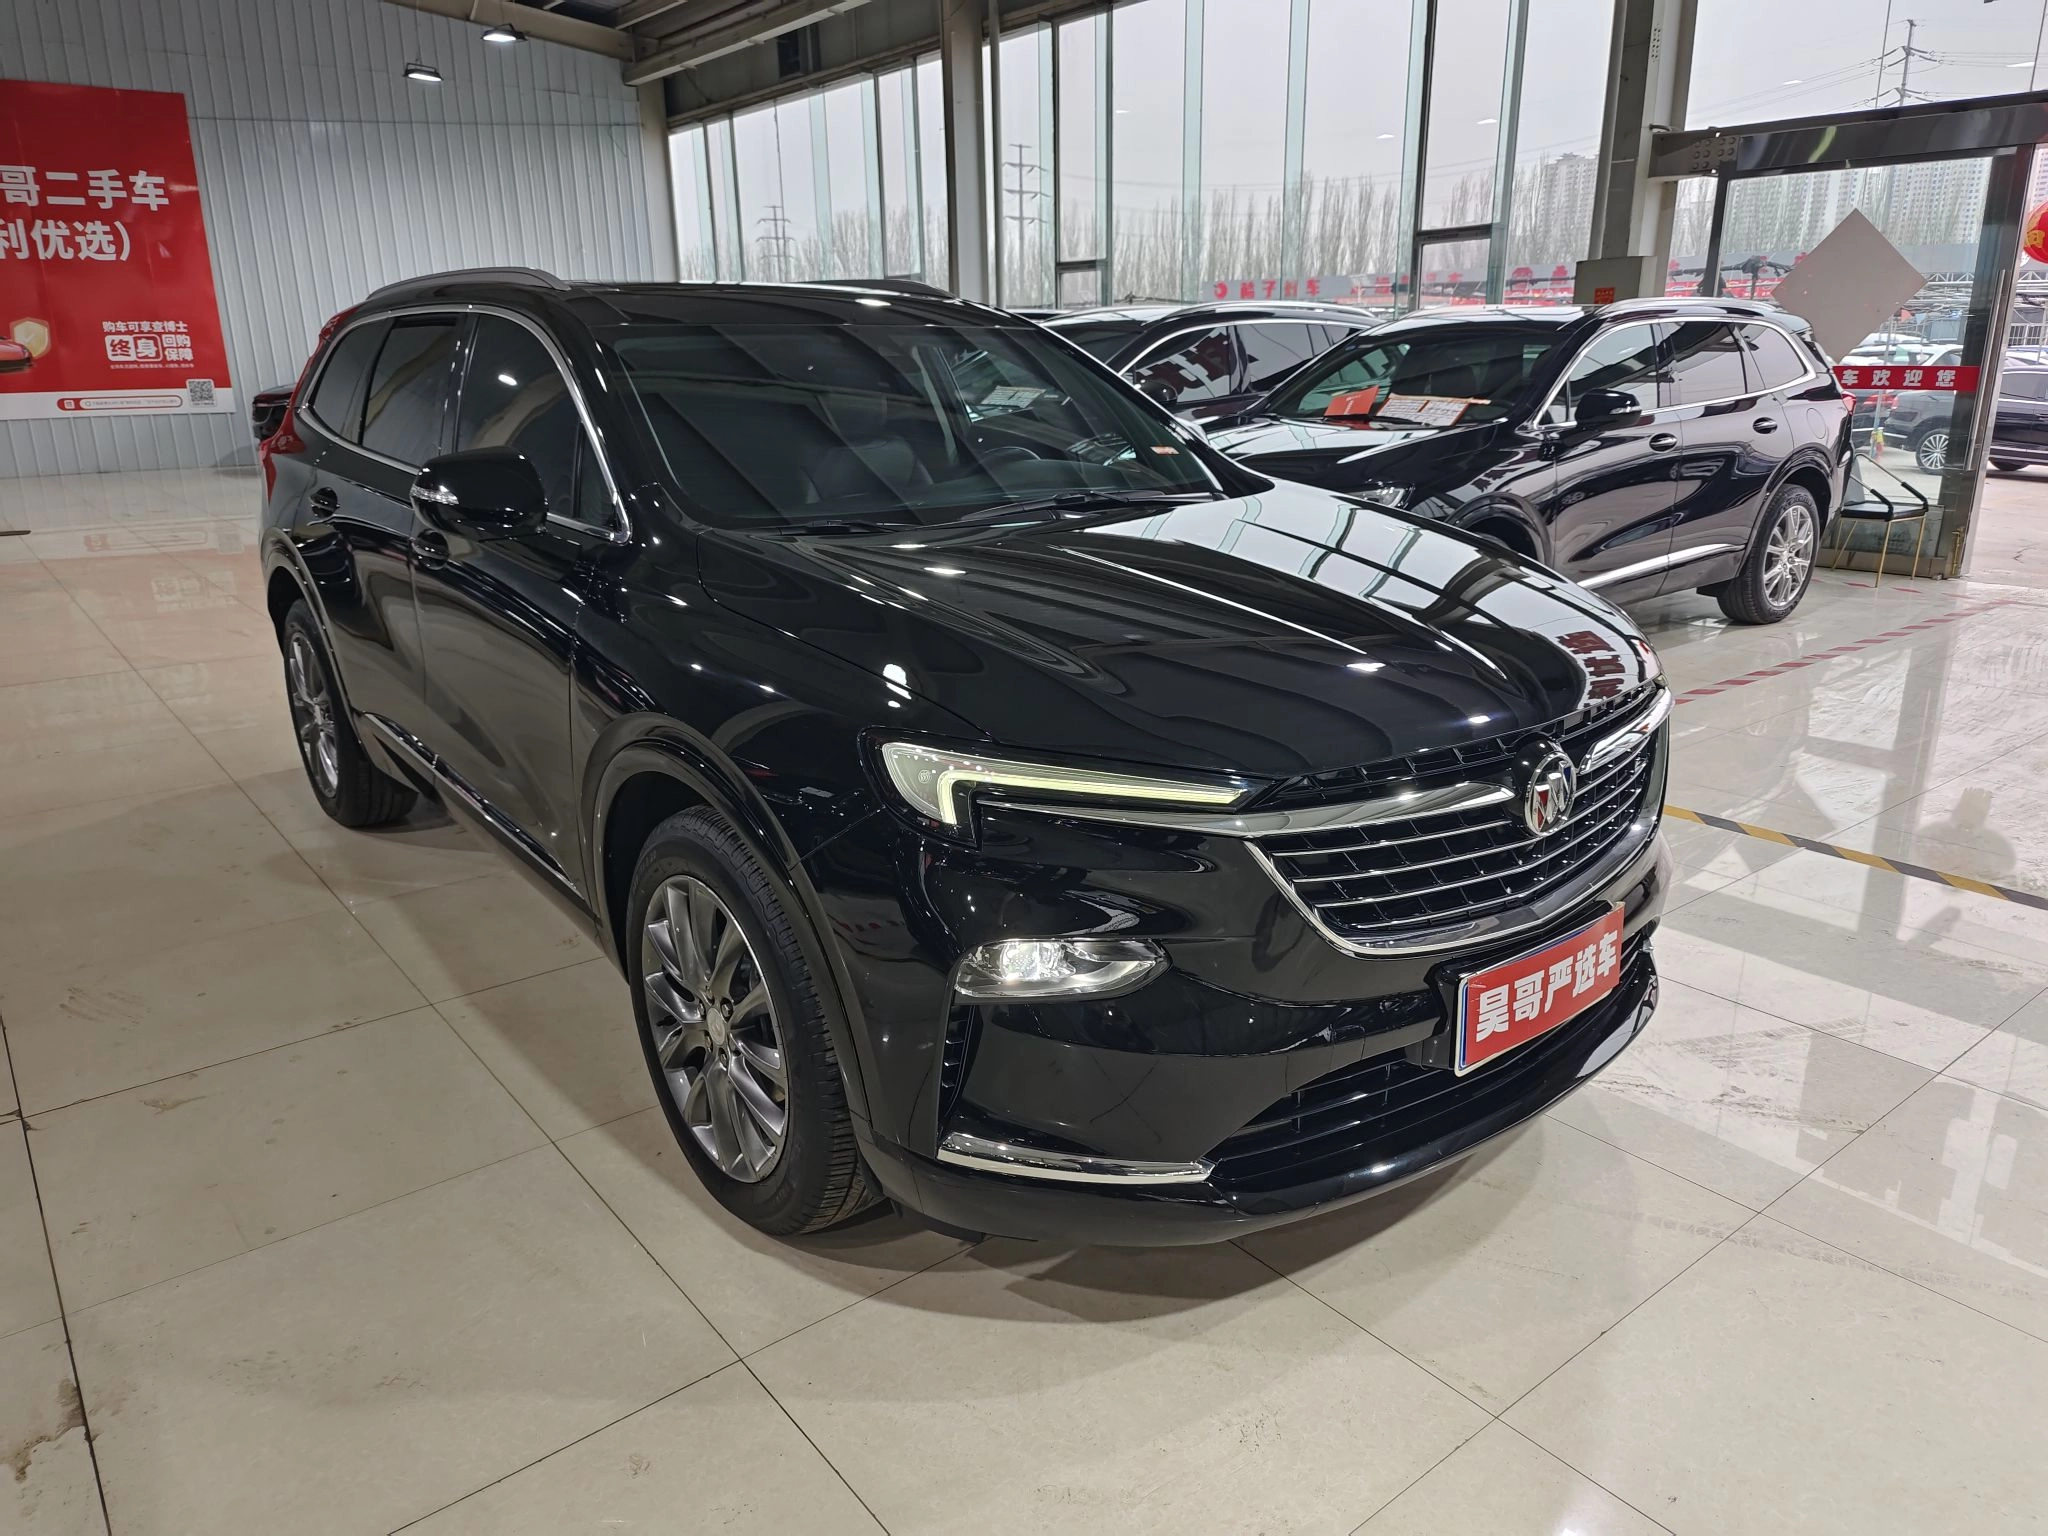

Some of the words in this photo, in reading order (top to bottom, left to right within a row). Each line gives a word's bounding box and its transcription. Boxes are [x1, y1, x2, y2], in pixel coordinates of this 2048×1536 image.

[0, 165, 169, 211] 哥二手车
[109, 338, 157, 357] 终身
[162, 334, 191, 347] 回购
[1841, 369, 1956, 387] 车欢迎您
[1475, 929, 1618, 1042] 昊哥严选车
